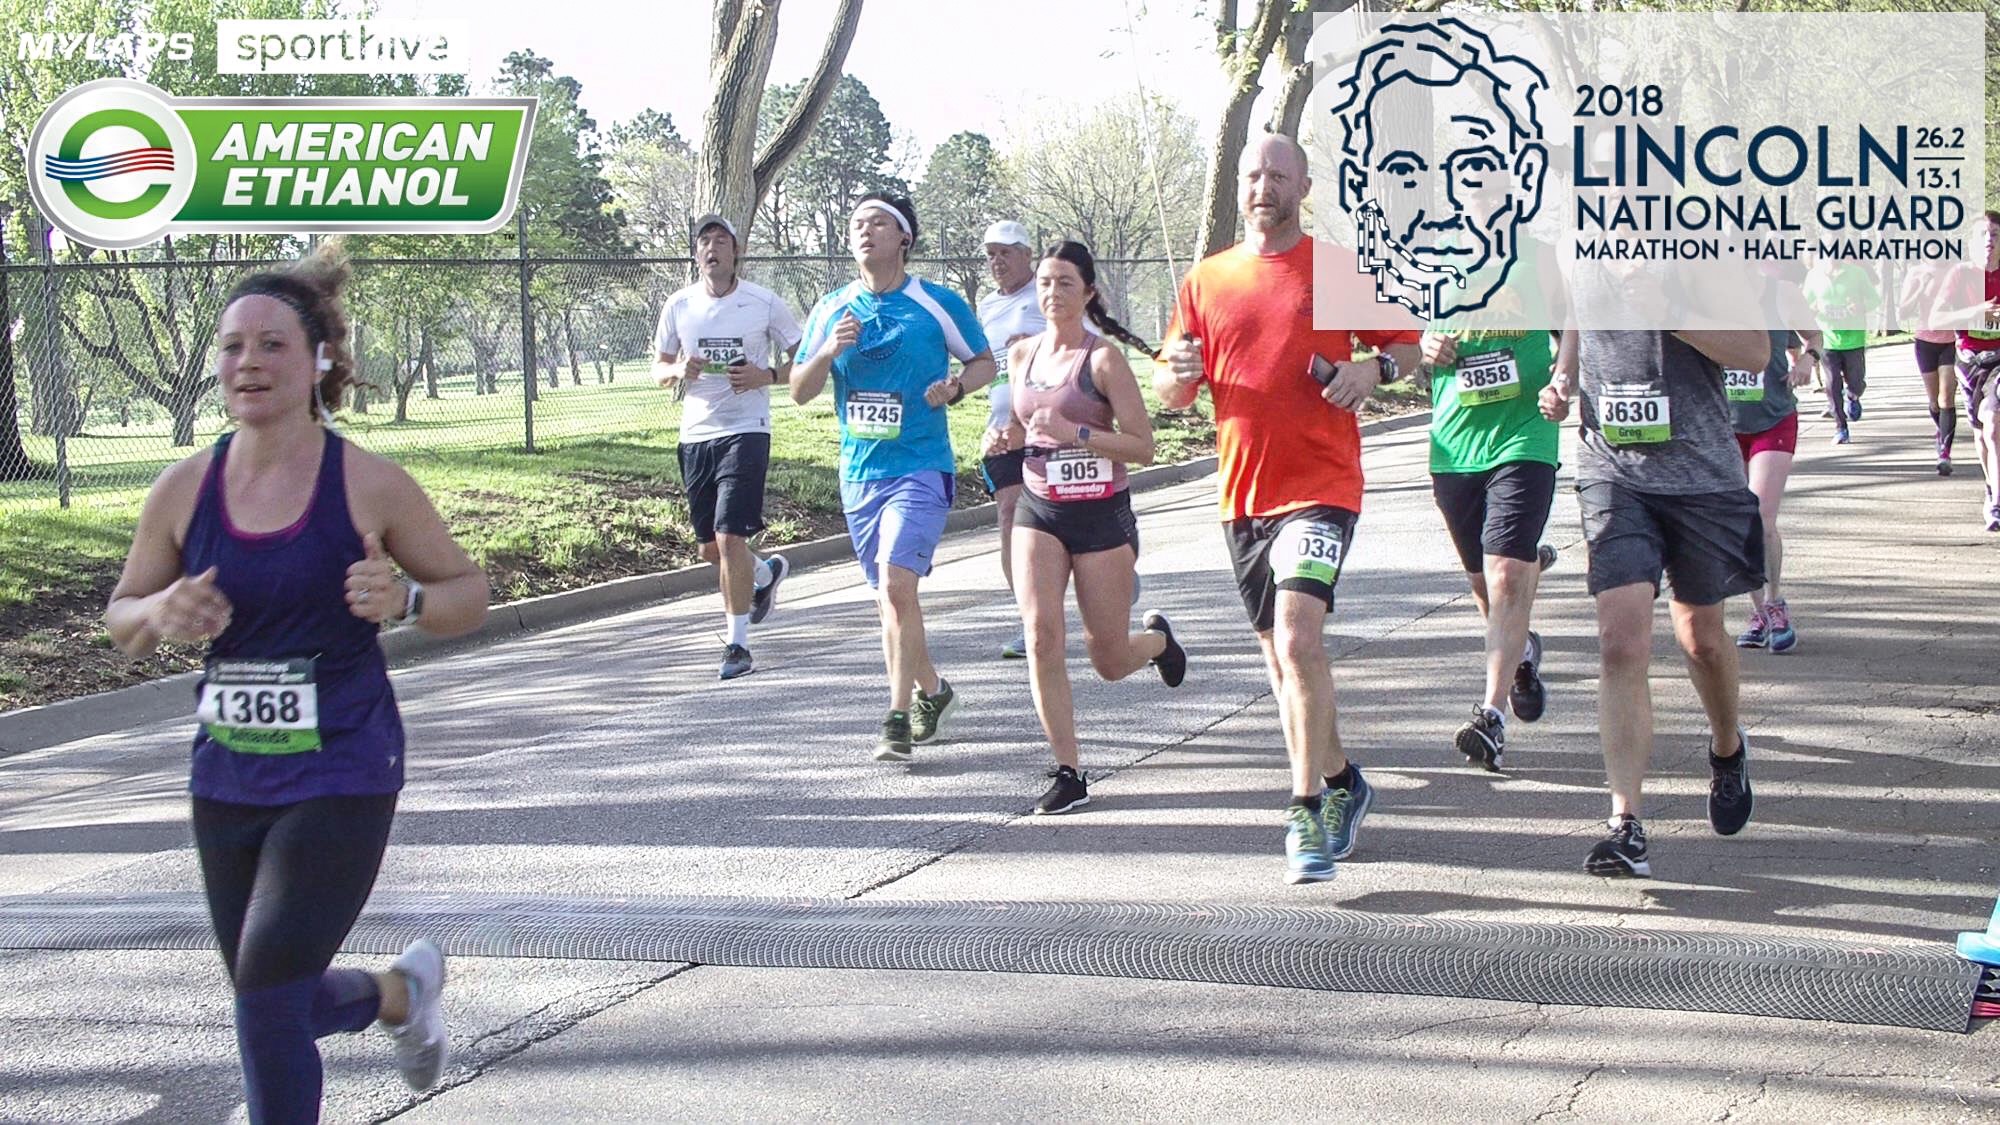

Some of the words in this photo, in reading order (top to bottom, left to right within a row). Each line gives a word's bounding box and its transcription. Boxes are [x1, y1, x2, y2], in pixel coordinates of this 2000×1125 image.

[1462, 364, 1511, 389] 3858
[848, 404, 899, 423] 11245
[1605, 400, 1659, 423] 3630
[1618, 426, 1642, 439] Greg
[1060, 461, 1098, 481] 905
[1055, 482, 1106, 496] Wednesday
[213, 689, 300, 724] 1368
